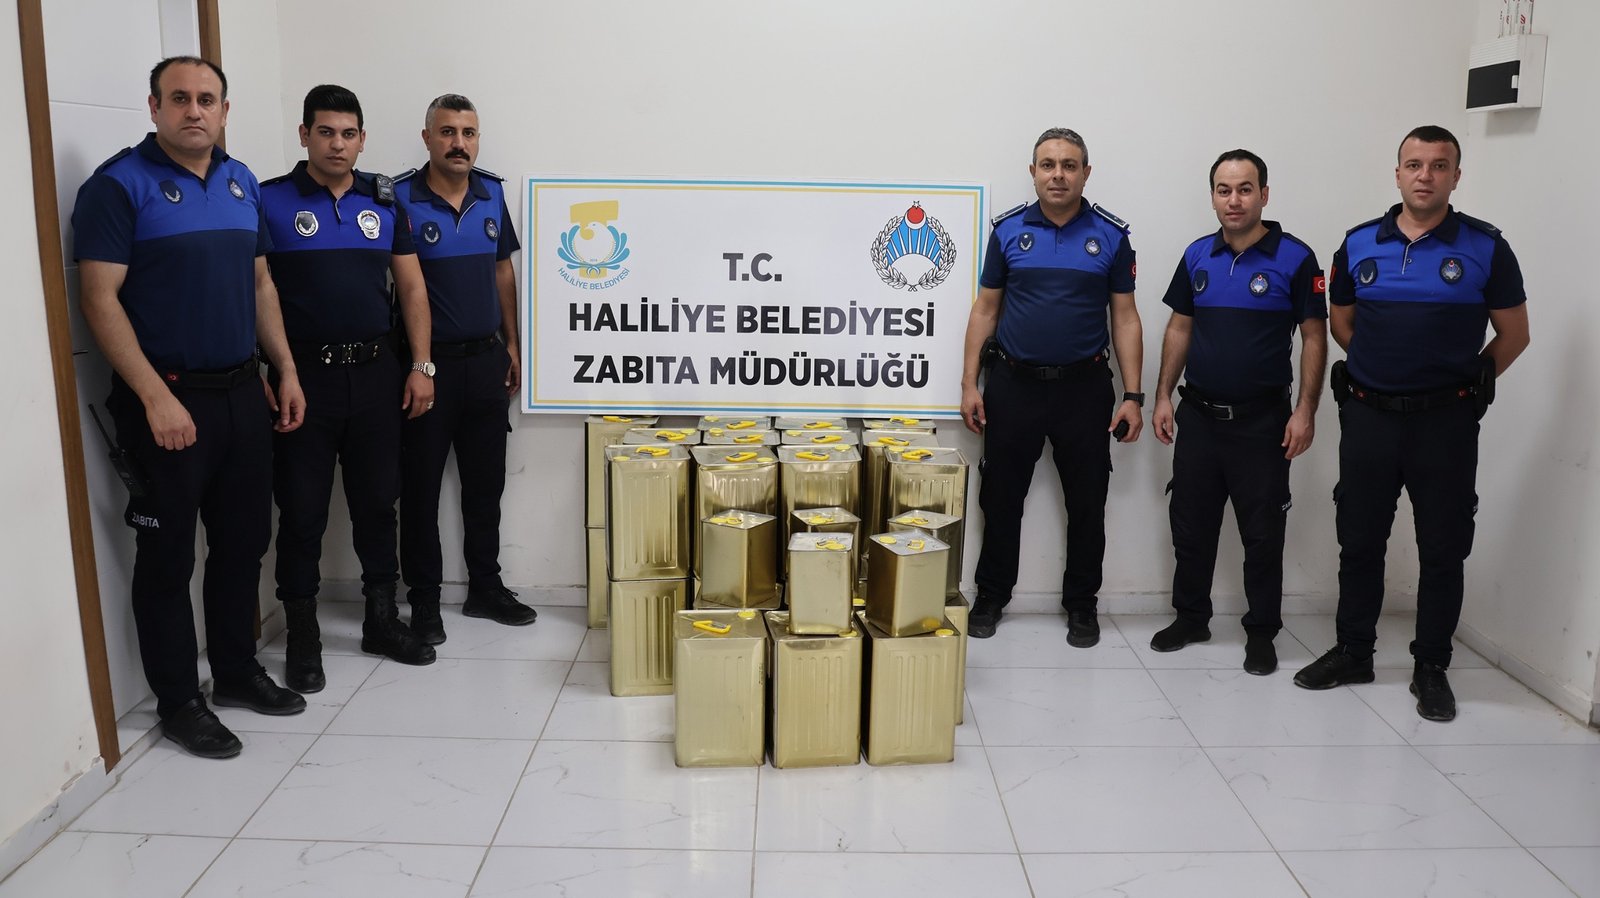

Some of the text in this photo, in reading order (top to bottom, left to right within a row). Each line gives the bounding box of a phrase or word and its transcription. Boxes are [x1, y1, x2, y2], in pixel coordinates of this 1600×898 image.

[722, 252, 783, 282] T.C.
[569, 297, 935, 337] HALİLİYE BELEDİYESİ
[573, 350, 930, 389] ZABITA MÜDÜRLÜĞÜ
